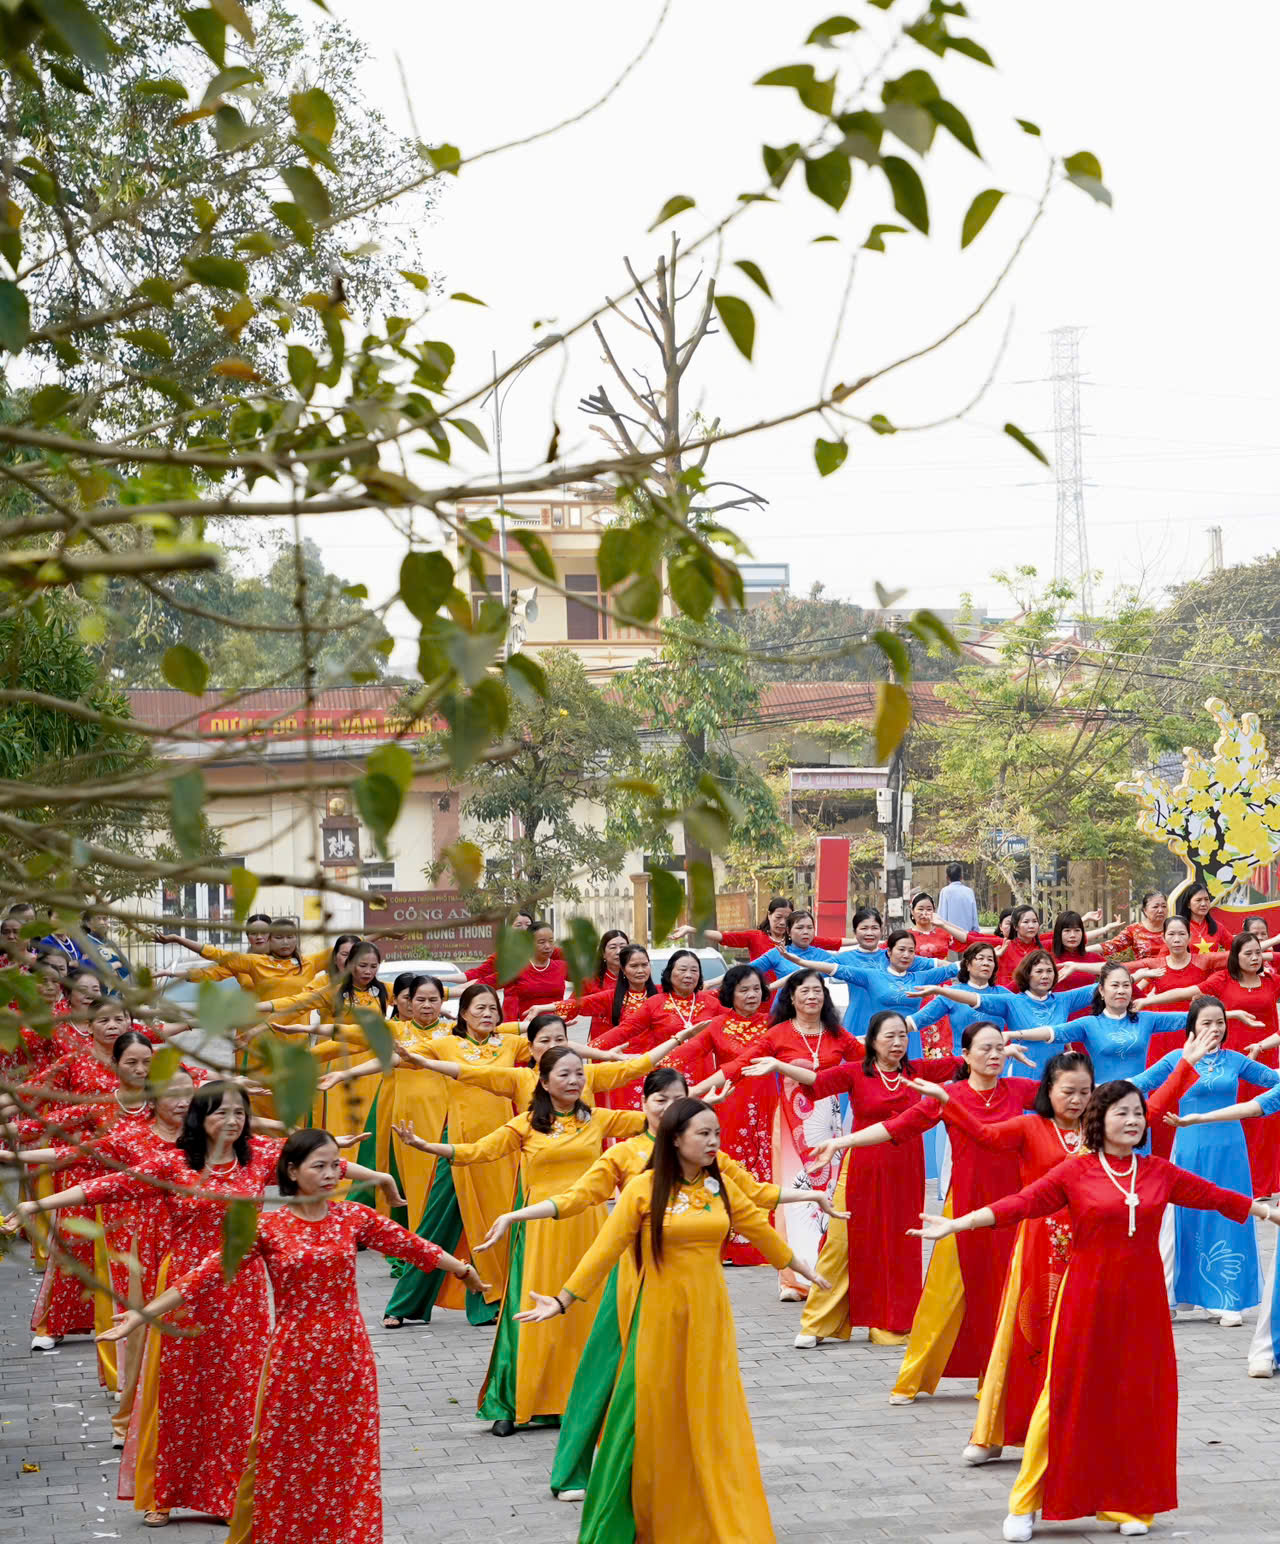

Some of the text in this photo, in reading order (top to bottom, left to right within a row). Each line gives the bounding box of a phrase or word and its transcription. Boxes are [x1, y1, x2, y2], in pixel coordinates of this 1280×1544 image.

[340, 713, 377, 735] VĂN
[384, 716, 432, 736] MNH
[393, 906, 473, 921] CÔNG AN
